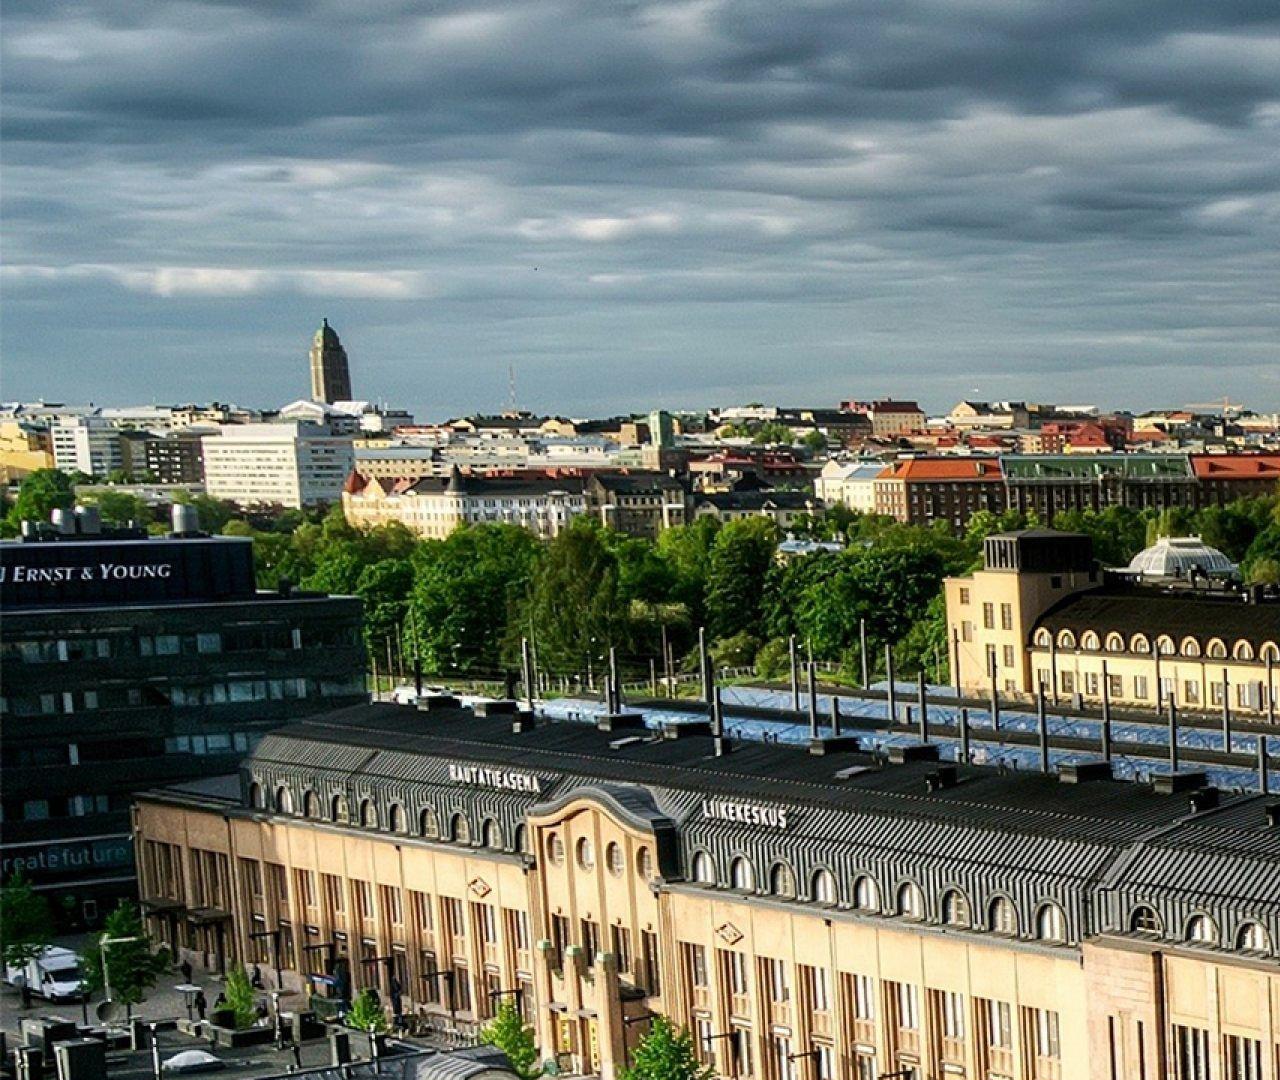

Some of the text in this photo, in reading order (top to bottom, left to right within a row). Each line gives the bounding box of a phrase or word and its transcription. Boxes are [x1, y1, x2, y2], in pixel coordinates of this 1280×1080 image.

[12, 563, 172, 583] ERNST & YOUNG
[702, 800, 787, 829] LIIKEKESKUS
